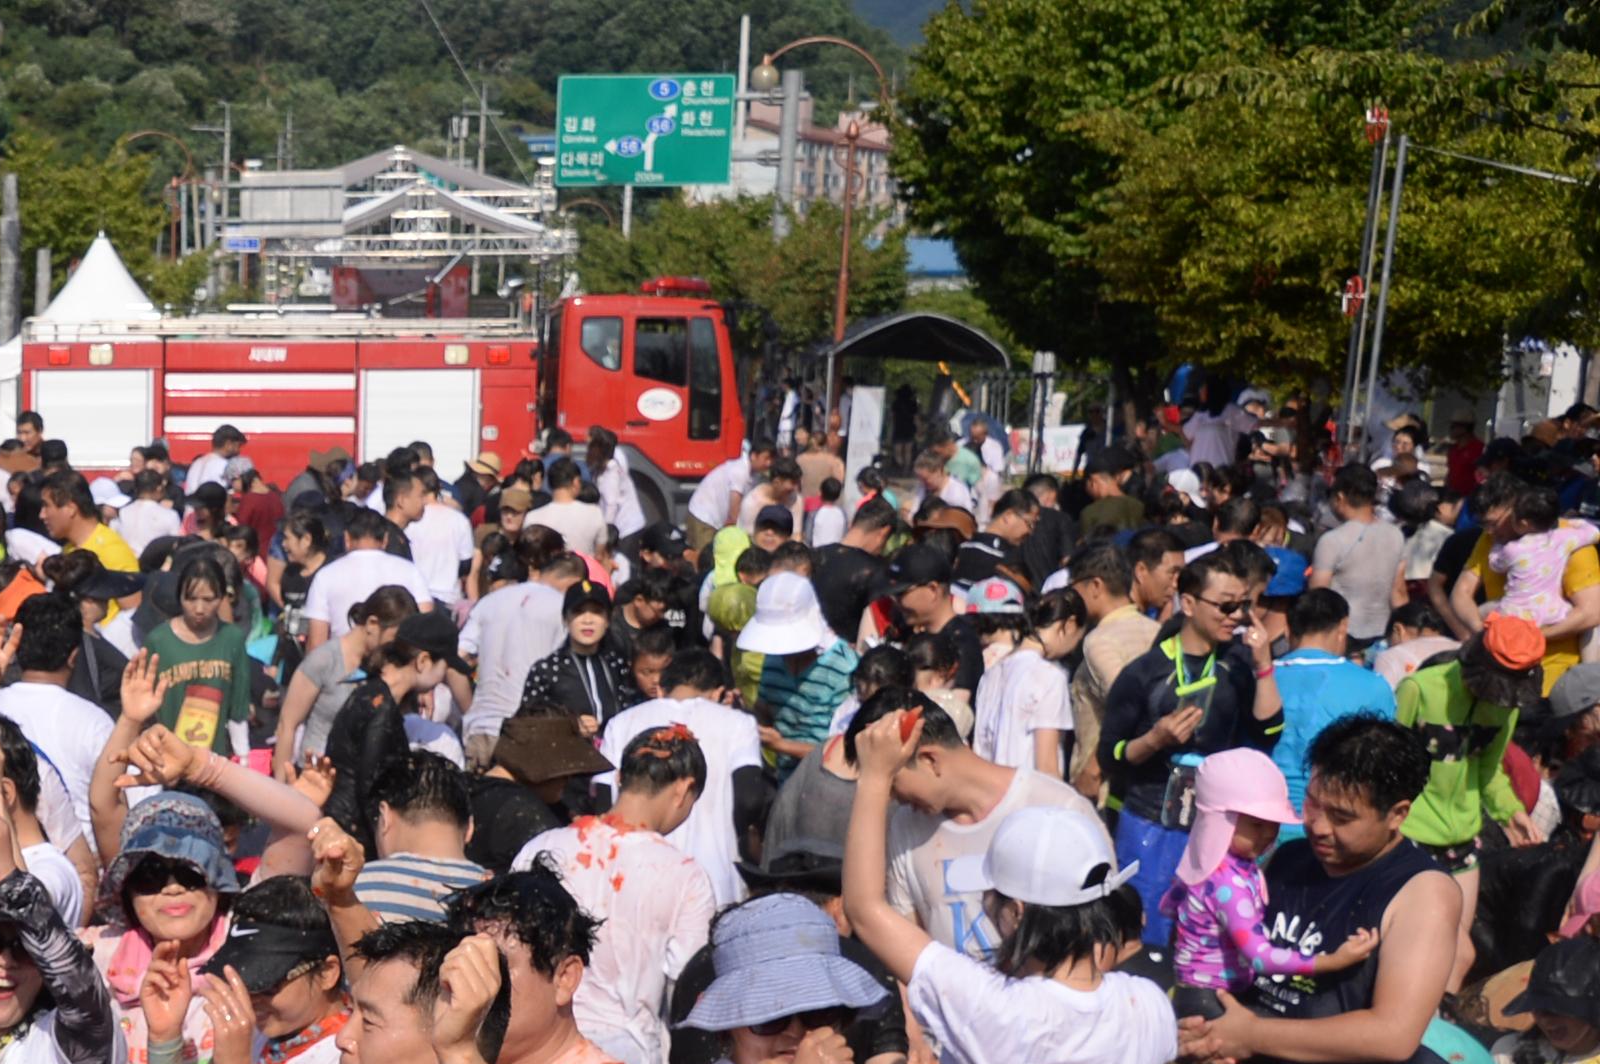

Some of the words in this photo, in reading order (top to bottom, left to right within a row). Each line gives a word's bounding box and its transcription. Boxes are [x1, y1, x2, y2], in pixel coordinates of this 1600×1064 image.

[658, 82, 671, 98] 5
[682, 79, 715, 98] 춘천
[563, 115, 597, 133] 김화
[652, 117, 671, 132] 56
[681, 110, 714, 127] 화천
